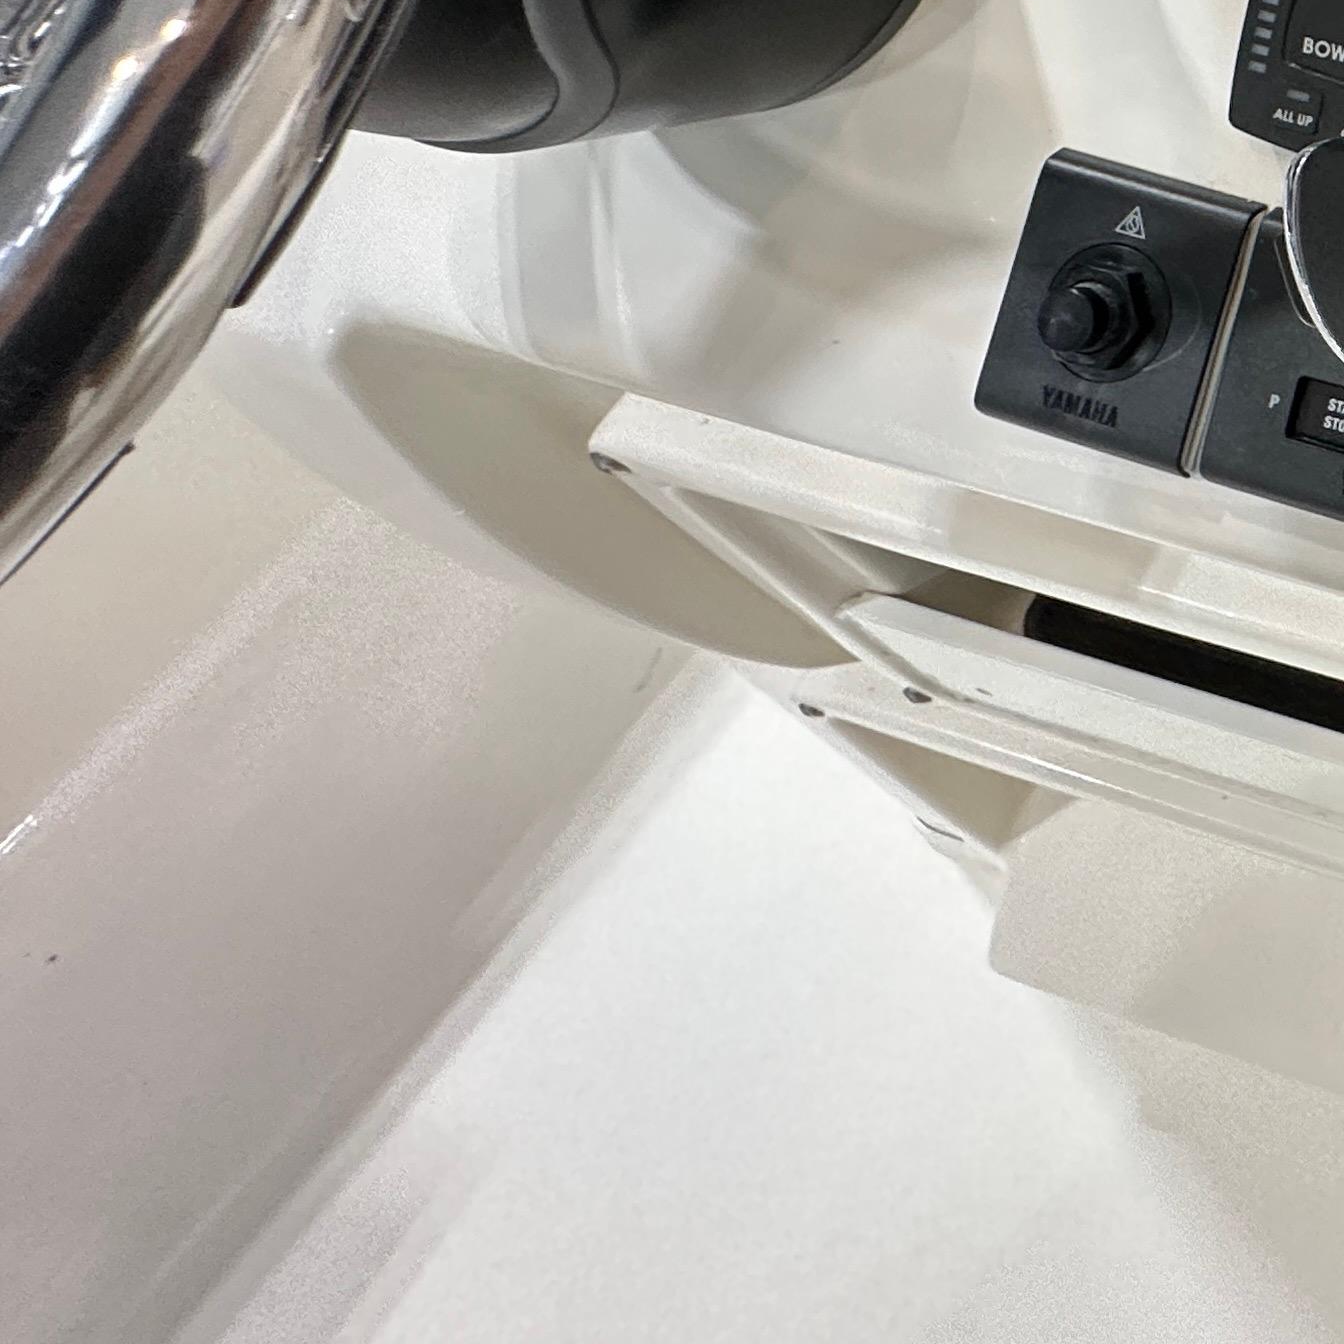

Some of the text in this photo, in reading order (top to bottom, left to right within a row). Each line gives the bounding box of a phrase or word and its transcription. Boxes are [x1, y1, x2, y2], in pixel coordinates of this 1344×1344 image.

[1272, 107, 1314, 127] ALL UP
[1042, 383, 1118, 428] YAMAHA
[1269, 394, 1281, 409] P
